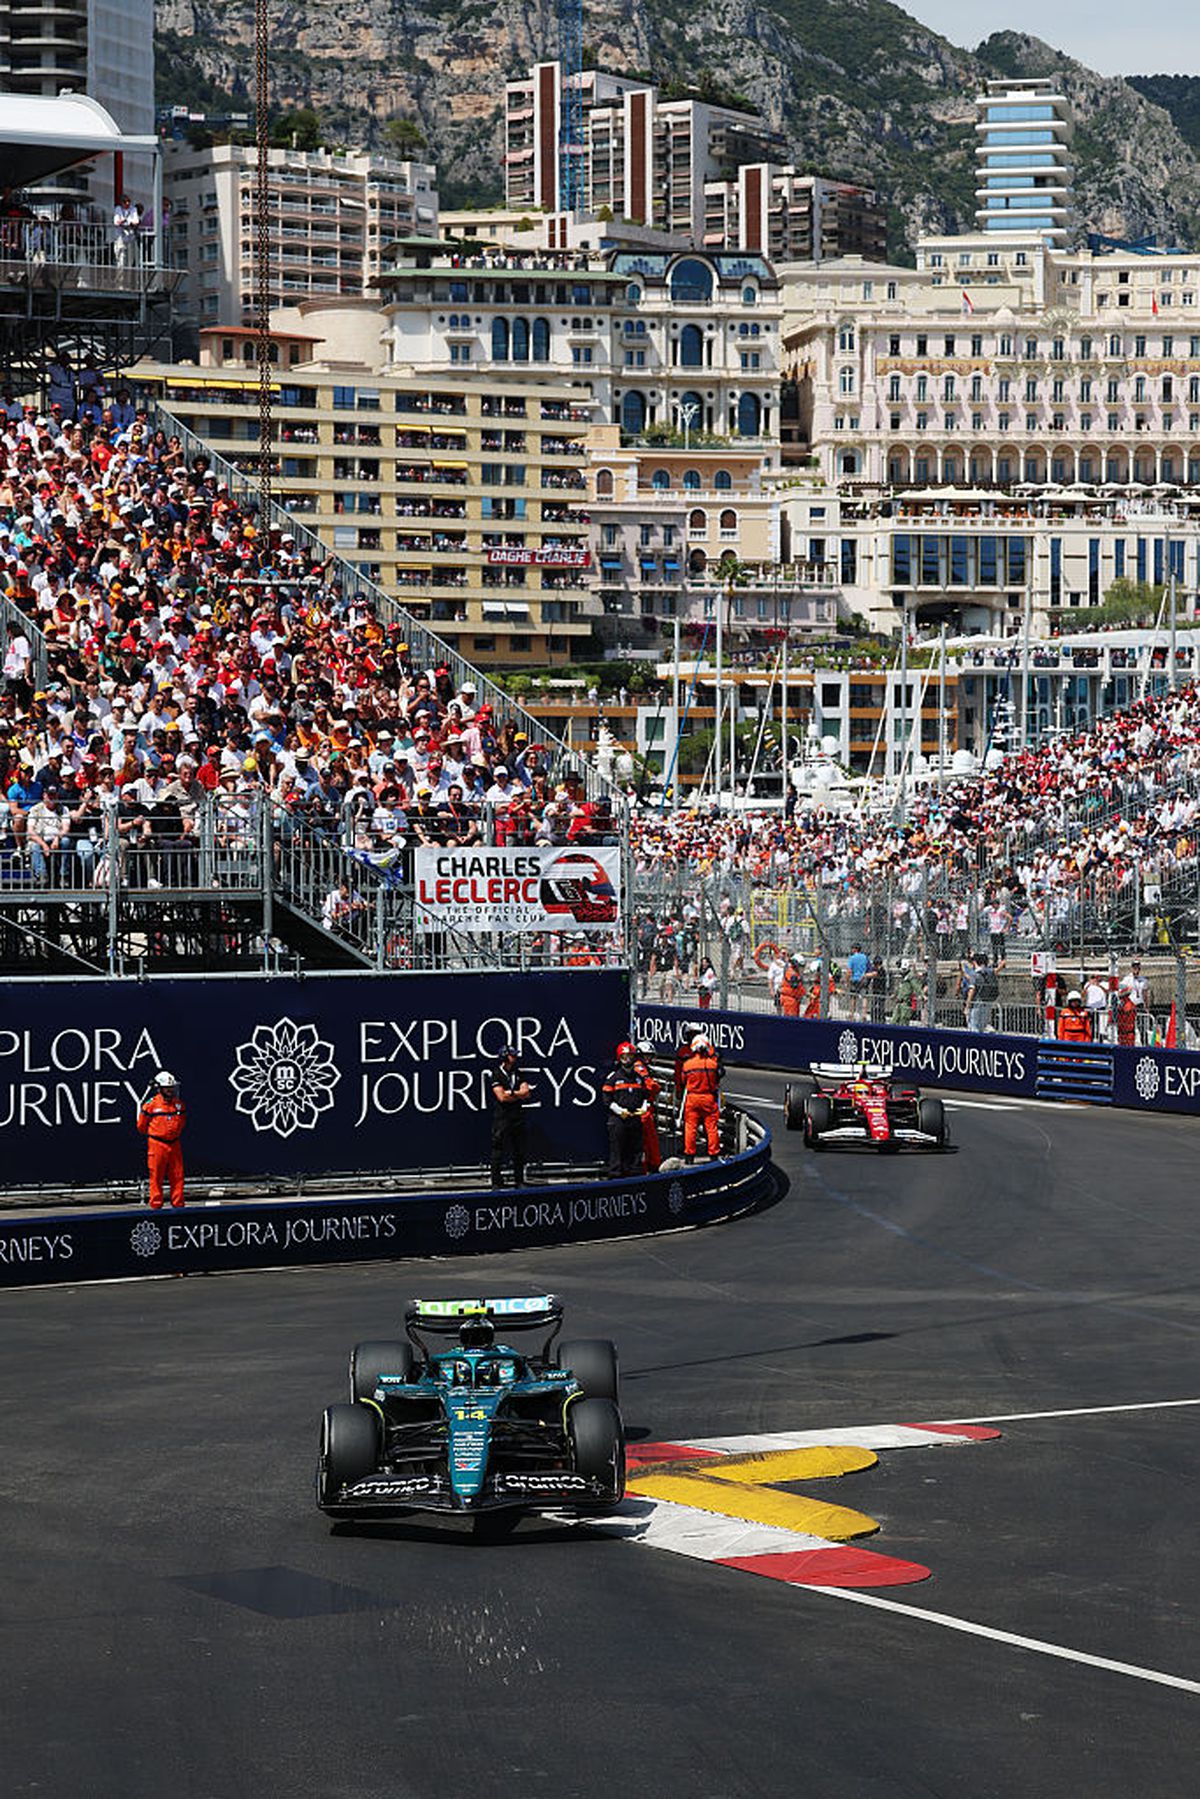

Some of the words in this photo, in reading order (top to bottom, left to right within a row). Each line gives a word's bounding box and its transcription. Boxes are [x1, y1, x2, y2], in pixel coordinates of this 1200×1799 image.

[437, 856, 541, 878] CHARLES
[419, 878, 538, 904] LECLERC
[475, 906, 530, 914] OFFICIAL
[360, 1016, 579, 1063] EXPLORA
[634, 1017, 673, 1043] LORA
[675, 1020, 744, 1050] JORNEYS
[862, 1037, 935, 1071] EXPLORA
[937, 1045, 1025, 1080] JOURNEYS
[475, 1206, 564, 1231] EXPLORA
[568, 1192, 648, 1228] JOURNEYS
[168, 1221, 278, 1250] EXPLORA
[283, 1214, 397, 1249] JOURNEYS
[454, 1409, 487, 1421] 14
[505, 1474, 586, 1489] aramco
